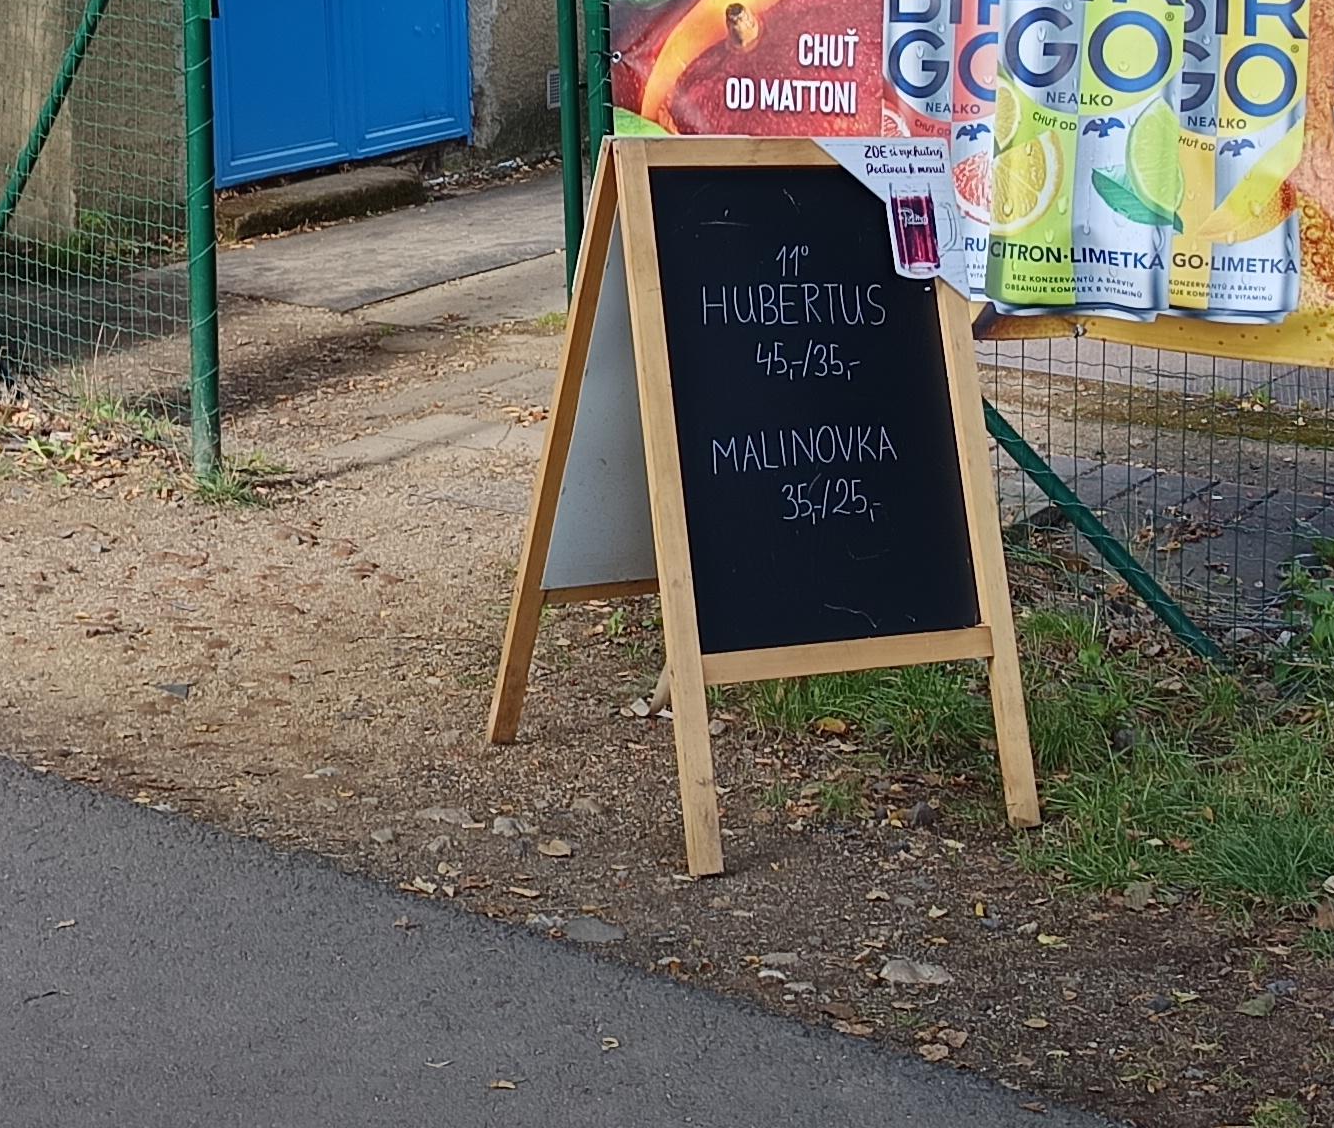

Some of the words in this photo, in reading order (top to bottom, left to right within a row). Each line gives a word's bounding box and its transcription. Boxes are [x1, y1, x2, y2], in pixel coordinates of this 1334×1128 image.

[798, 28, 860, 68] CHUŤ
[1004, 6, 1173, 94] GO
[726, 77, 755, 110] OD
[760, 78, 857, 115] MATTONI
[1046, 90, 1114, 107] NEALKO
[925, 101, 981, 115] NEALKO
[1059, 120, 1078, 131] OD
[1187, 116, 1247, 130] NEALKO
[1178, 134, 1199, 149] HUŤ
[1200, 142, 1216, 153] OD
[1012, 274, 1027, 282] BEZ
[1004, 283, 1048, 293] OBSAHUJE
[1050, 285, 1094, 294] KOMPLEX
[701, 283, 887, 327] HUBERTUS
[712, 426, 898, 476] MALINOVKA
